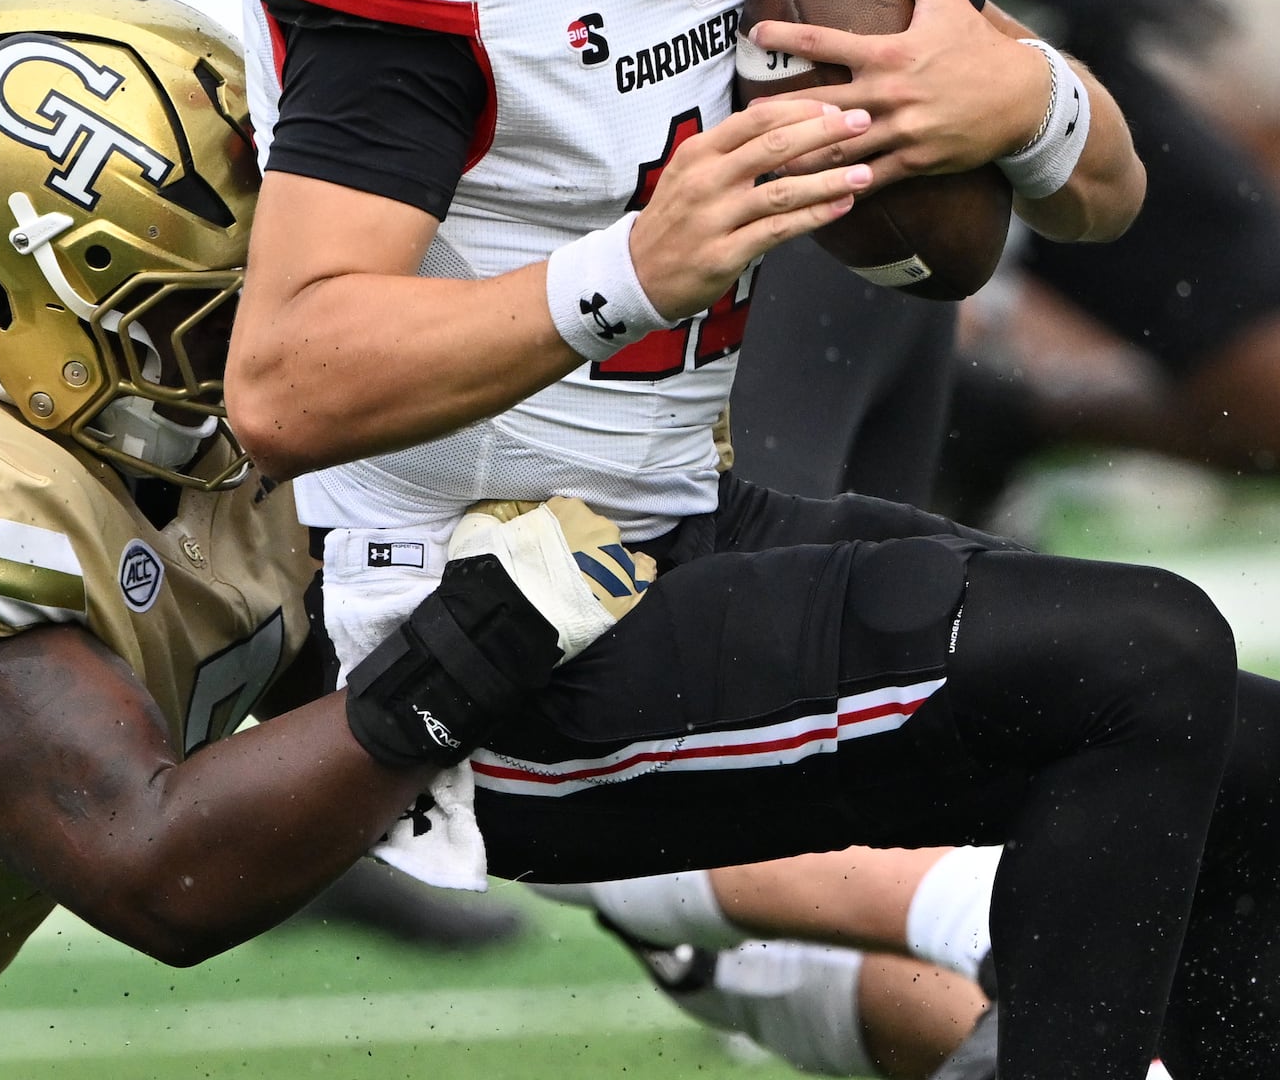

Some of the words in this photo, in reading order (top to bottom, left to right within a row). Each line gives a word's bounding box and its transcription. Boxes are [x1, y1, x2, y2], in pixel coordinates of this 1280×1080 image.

[568, 26, 589, 42] BIG
[615, 8, 740, 94] GARDNER
[126, 557, 152, 586] ACC
